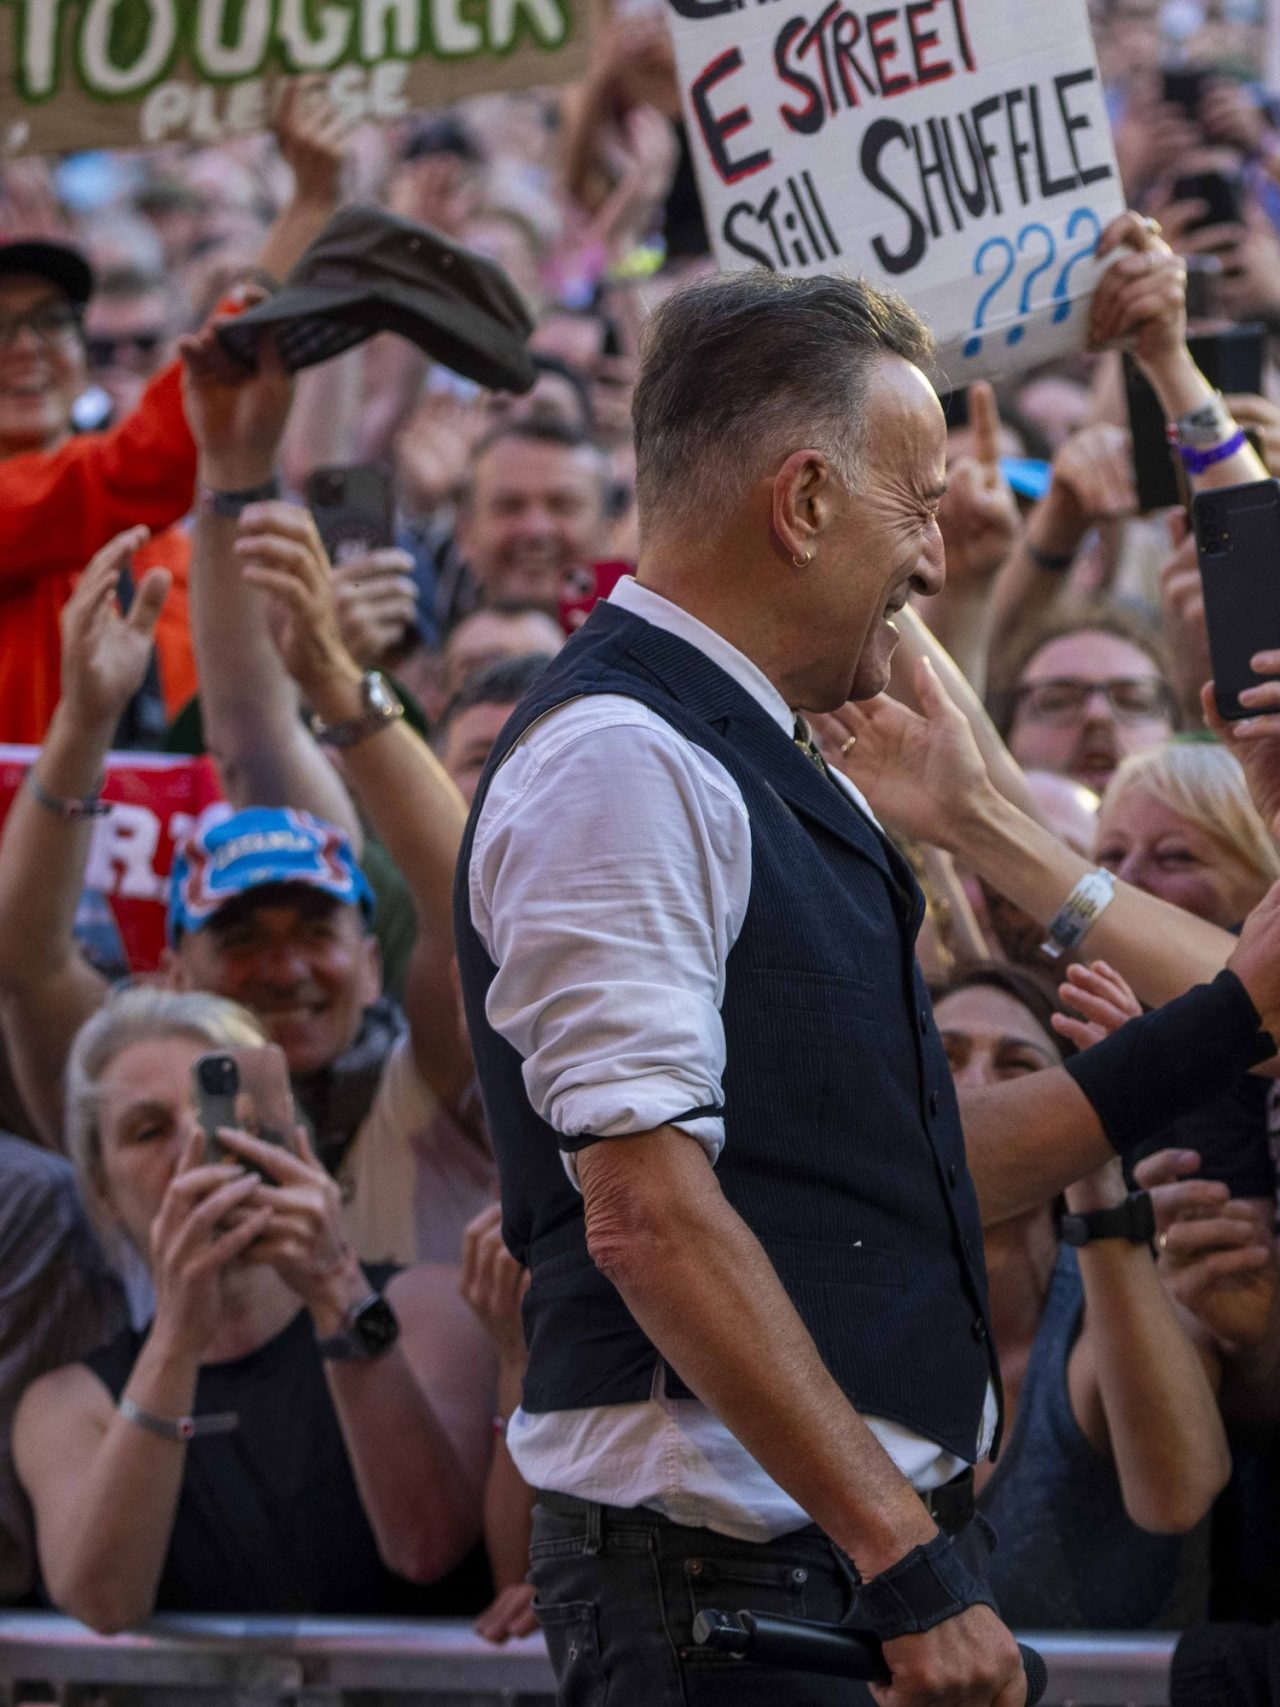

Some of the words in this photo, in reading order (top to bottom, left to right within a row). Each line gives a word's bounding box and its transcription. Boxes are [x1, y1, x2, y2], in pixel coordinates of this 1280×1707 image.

[141, 64, 410, 141] PLESE
[691, 46, 774, 186] E
[774, 0, 978, 135] STREET
[860, 68, 1112, 274] SHUFFLE
